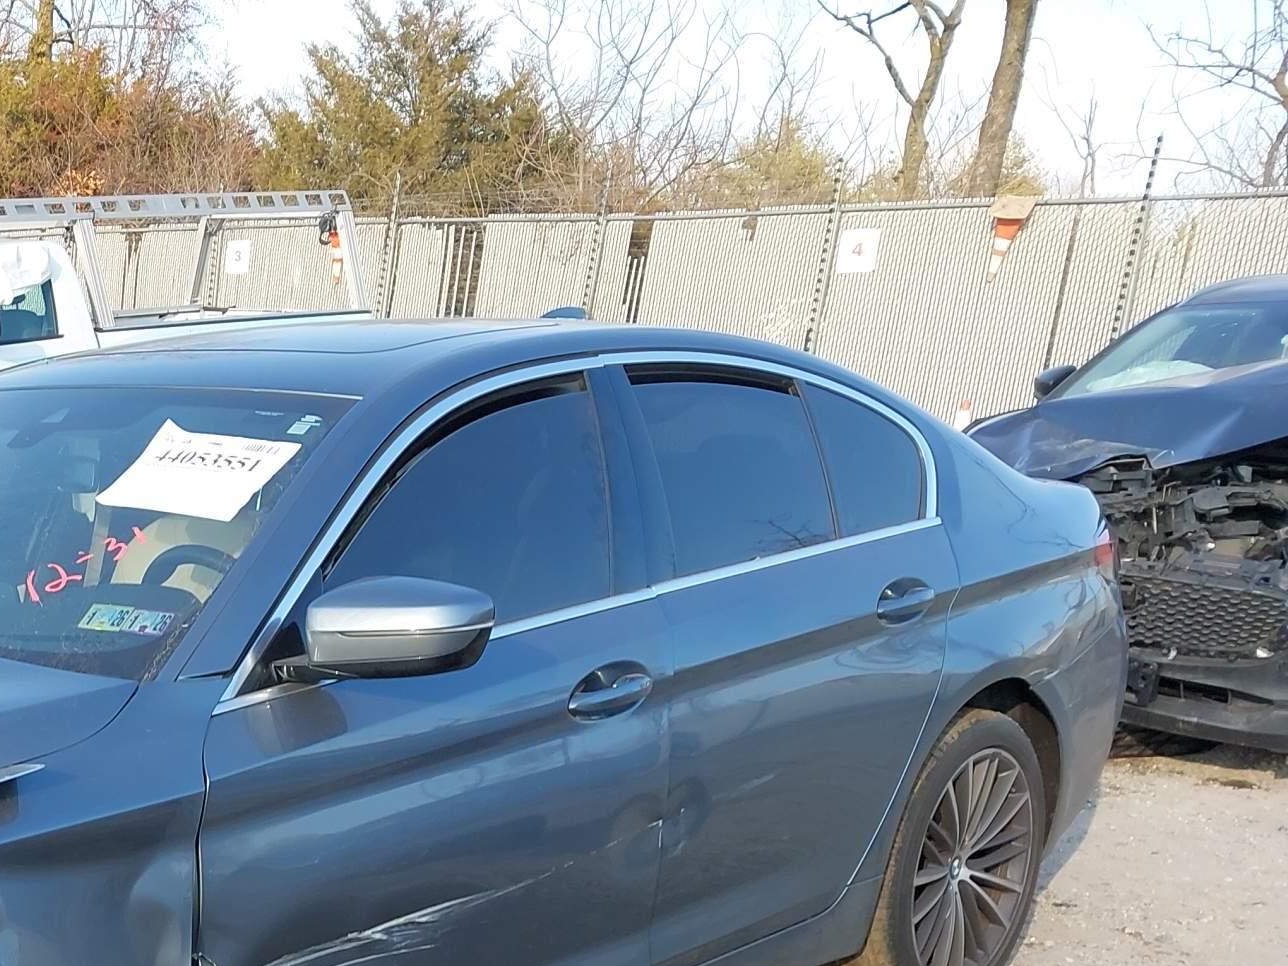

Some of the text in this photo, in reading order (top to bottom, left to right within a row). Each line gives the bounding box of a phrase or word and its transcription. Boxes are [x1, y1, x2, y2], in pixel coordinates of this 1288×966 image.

[234, 250, 242, 262] 3
[852, 242, 863, 257] 4
[155, 449, 261, 473] 44053551
